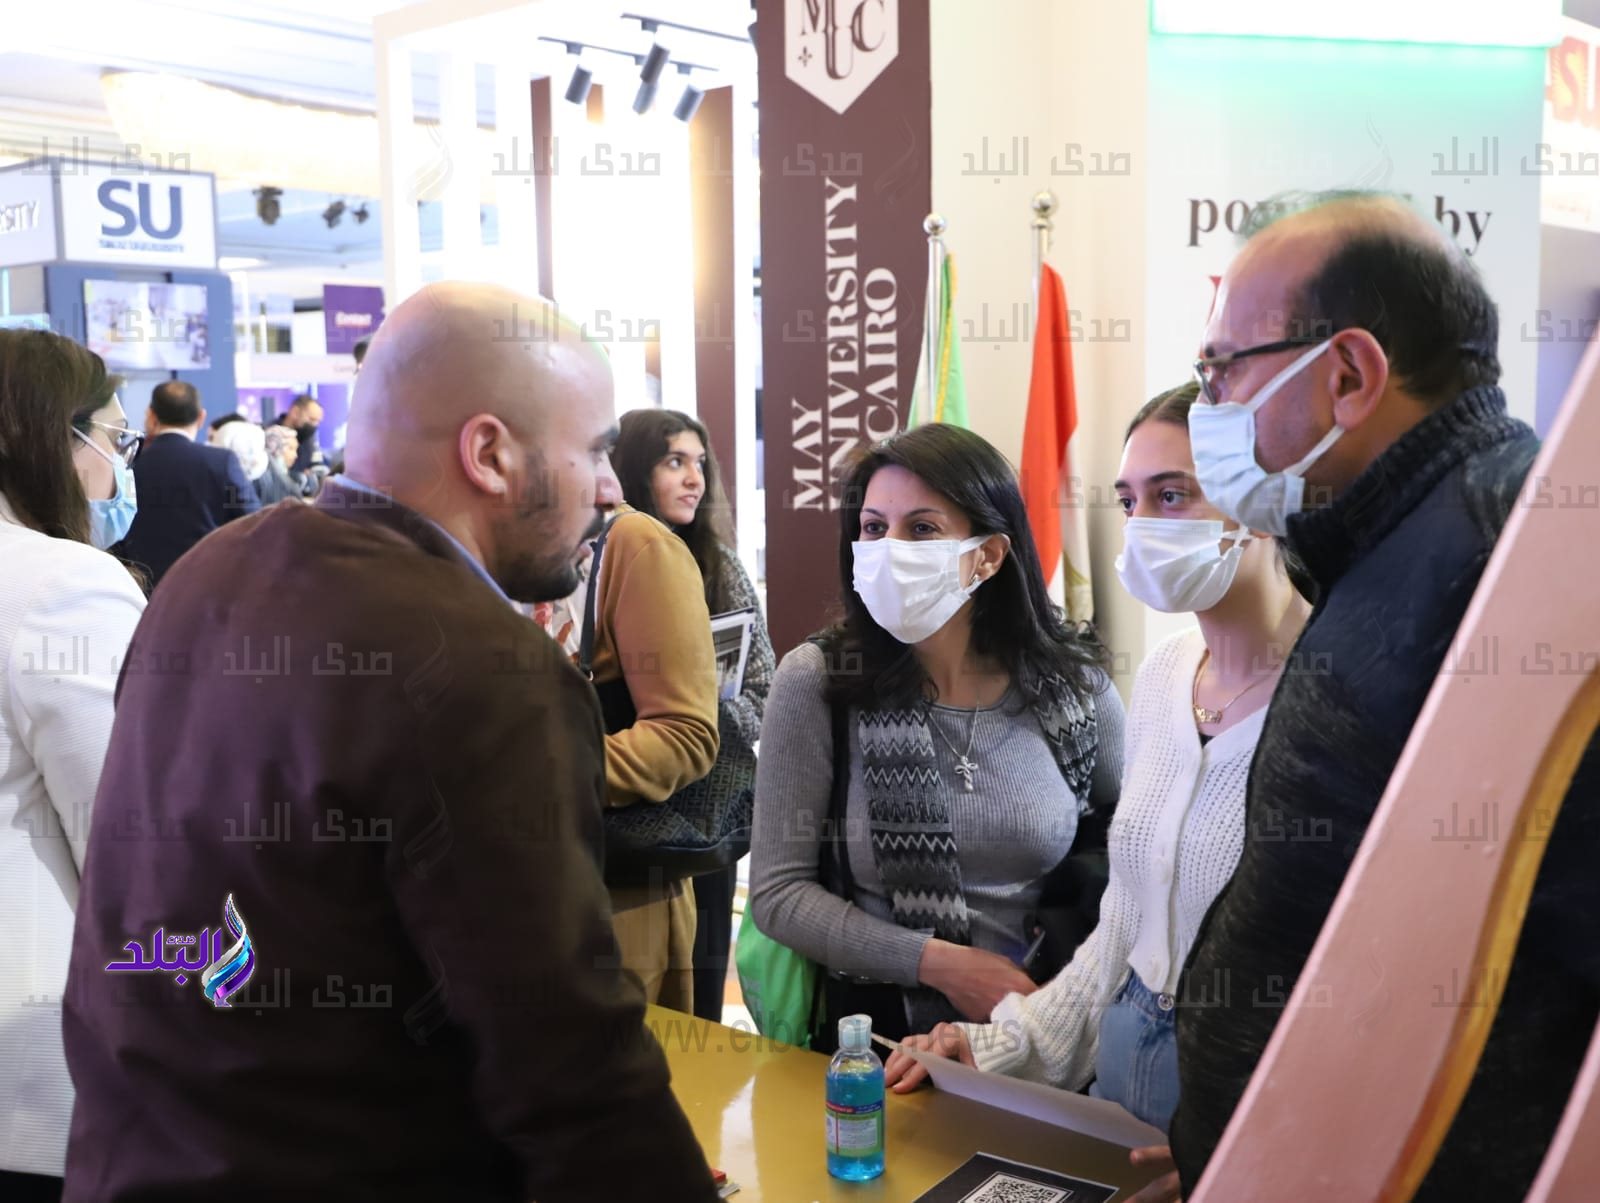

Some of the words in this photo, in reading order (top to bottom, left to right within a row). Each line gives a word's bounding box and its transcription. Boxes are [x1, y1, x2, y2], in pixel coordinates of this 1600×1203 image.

[97, 179, 183, 240] SU
[863, 267, 899, 445] CAIRO
[792, 397, 823, 511] MAY
